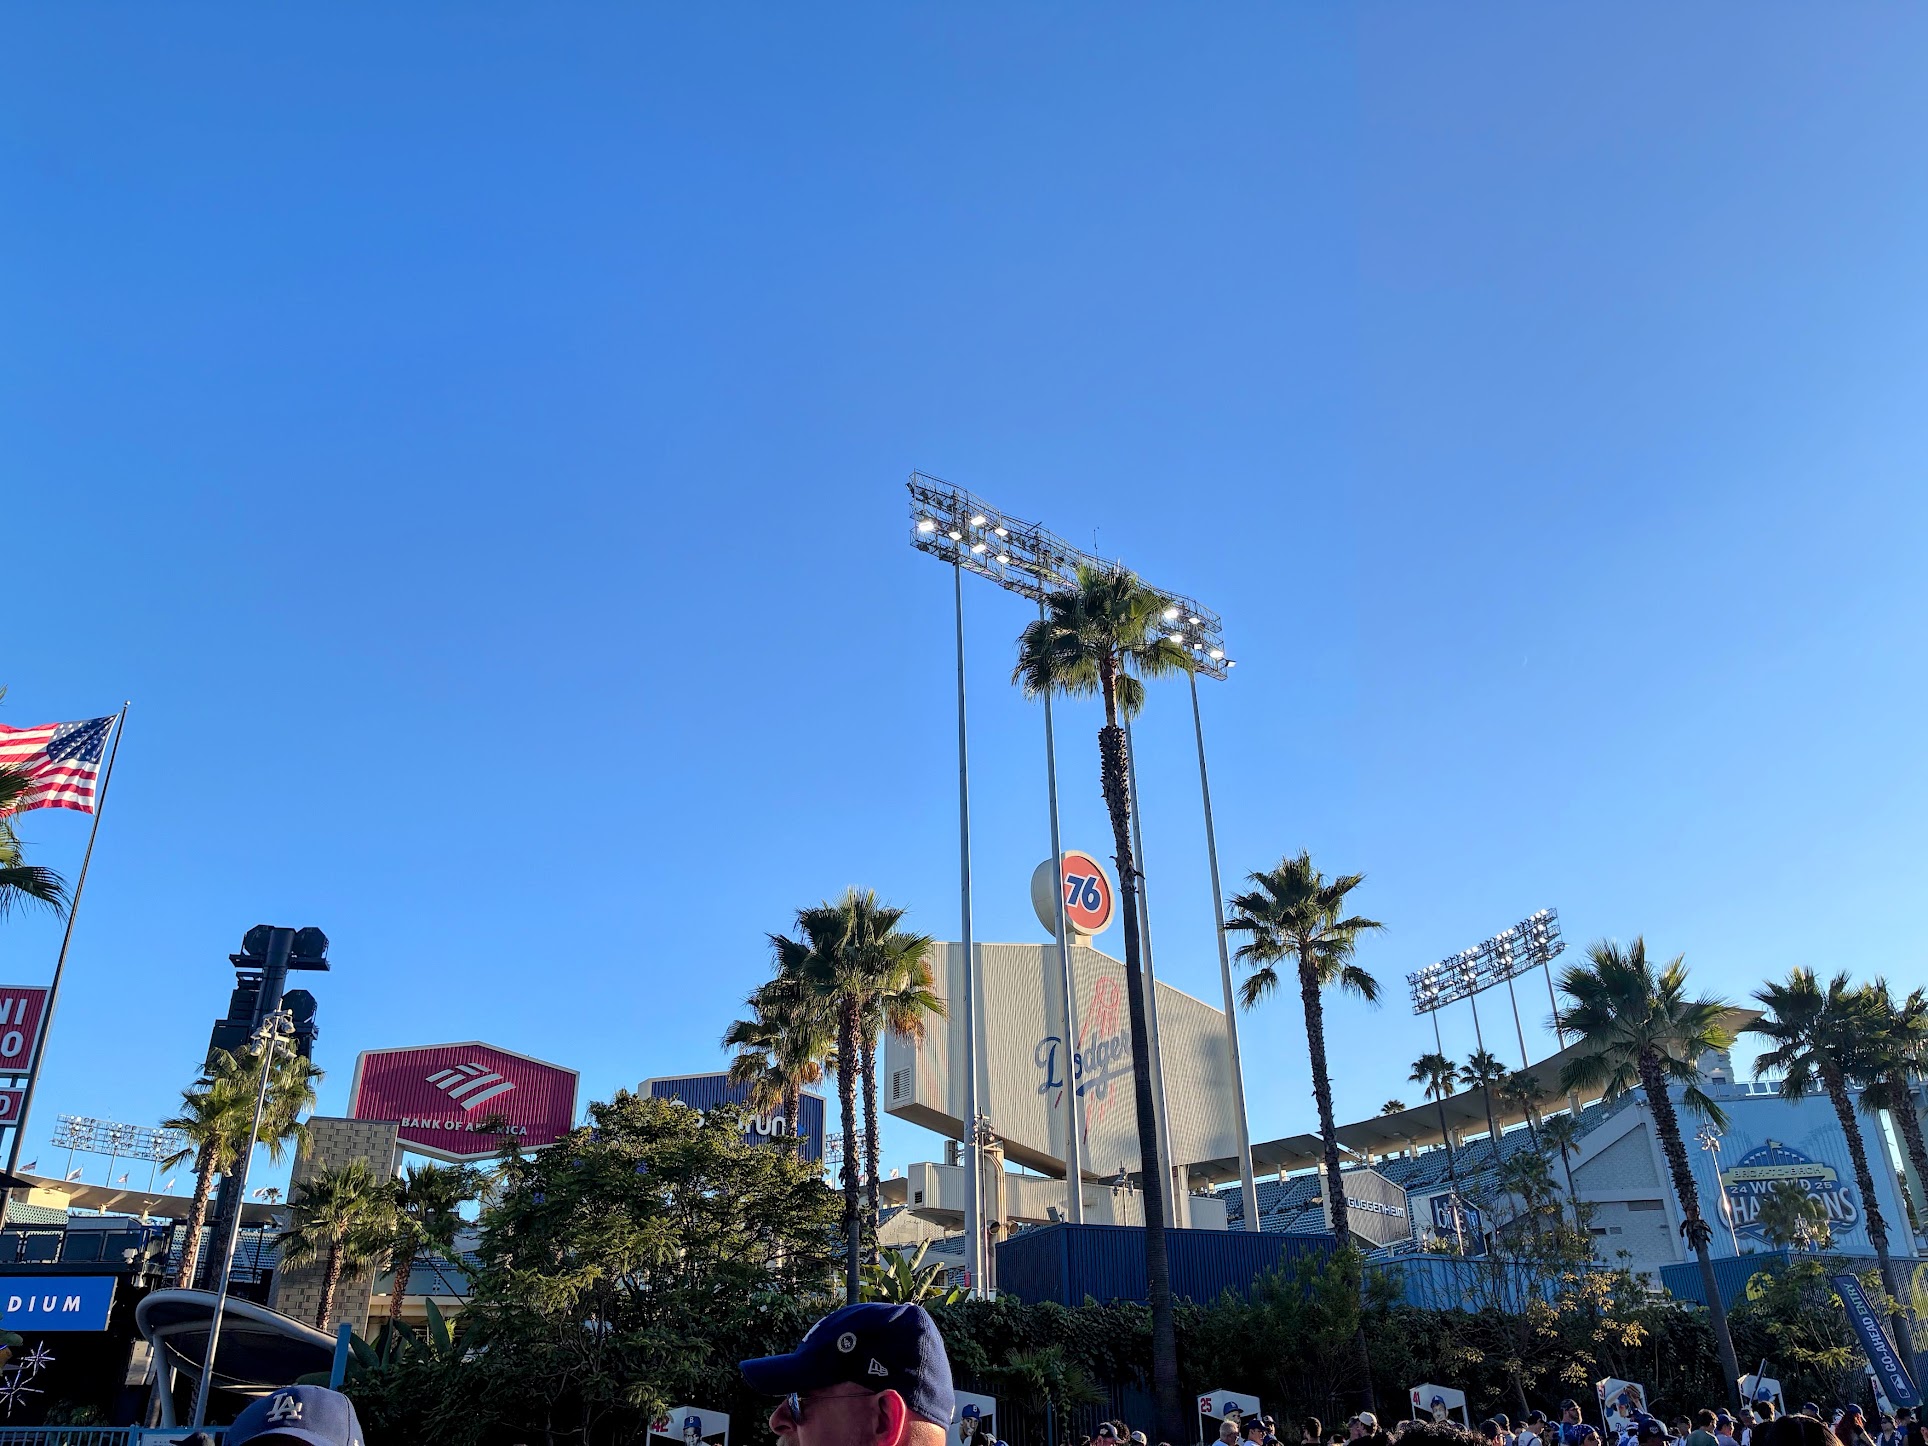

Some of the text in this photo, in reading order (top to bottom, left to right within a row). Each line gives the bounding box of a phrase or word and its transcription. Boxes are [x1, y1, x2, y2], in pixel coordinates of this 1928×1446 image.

[1064, 873, 1102, 913] 76
[2, 1031, 24, 1058] O
[1035, 1029, 1132, 1100] Dodger
[401, 1117, 441, 1130] BANK
[444, 1120, 462, 1131] OF
[1730, 1186, 1747, 1194] 24
[1814, 1181, 1833, 1189] 25
[1347, 1196, 1405, 1218] GUGGENHEIM
[7, 1295, 81, 1312] DIUM
[1843, 1283, 1897, 1372] GO-AHEAD ENTRY
[266, 1392, 303, 1422] LA
[1200, 1397, 1212, 1412] 25
